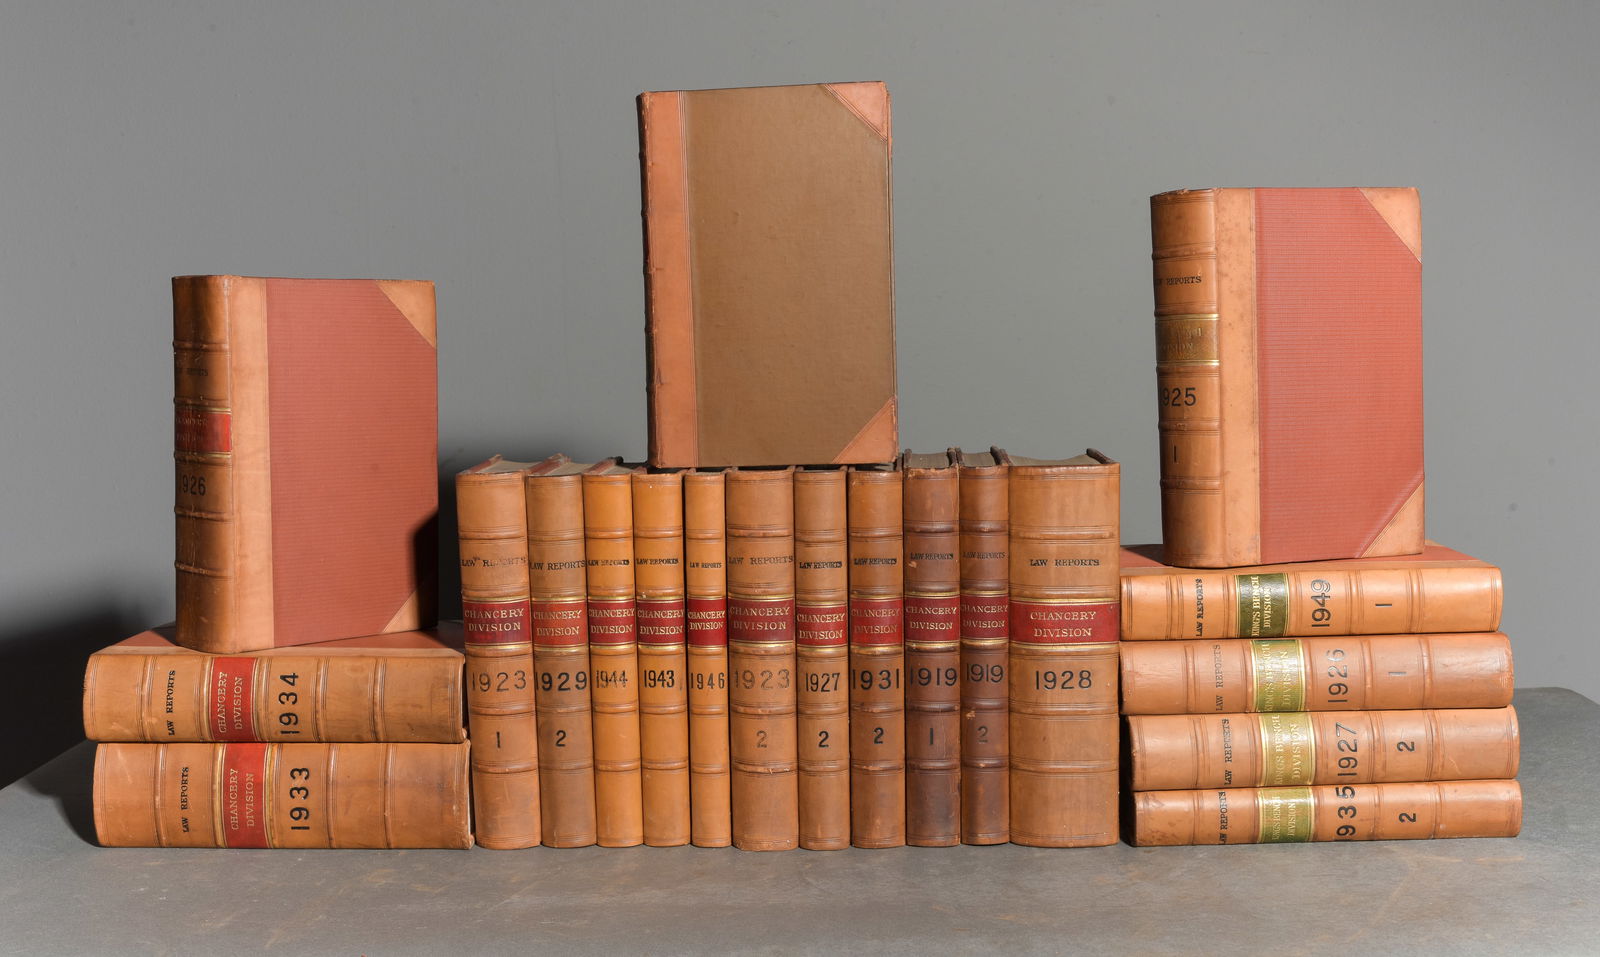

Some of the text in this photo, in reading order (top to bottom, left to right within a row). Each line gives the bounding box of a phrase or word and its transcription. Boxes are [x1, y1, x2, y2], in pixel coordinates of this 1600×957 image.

[1167, 275, 1202, 286] REPORTS
[1160, 387, 1197, 407] 925
[1173, 445, 1178, 463] 1
[750, 555, 794, 565] REPORTS
[910, 552, 954, 560] LAW REPORTS
[977, 552, 1005, 560] REPORTS
[530, 561, 586, 570] LAW REPORTS
[813, 561, 842, 569] REPORTS
[1196, 578, 1204, 619] REPORTS
[1251, 575, 1262, 606] BENCH
[906, 606, 957, 615] CHANCERY
[961, 605, 1008, 613] CHANCERY
[1263, 587, 1273, 628] DIVISION
[1311, 579, 1331, 627] 1949
[464, 608, 525, 619] CHANCERY
[533, 610, 582, 619] CHANCERY
[589, 608, 635, 618] CHANCERY
[637, 609, 684, 619] CHANCERY
[688, 611, 726, 619] CHANCERY
[730, 607, 790, 617] CHANCERY
[797, 613, 845, 623] CHANCERY
[851, 608, 900, 618] CHANCERY
[1030, 611, 1097, 620] CHANCERY
[468, 622, 521, 631] DIVISION
[537, 626, 580, 636] DIVISION
[591, 624, 633, 634] DIVISION
[640, 626, 683, 635] DIVISION
[690, 621, 723, 630] DIVISION
[734, 621, 786, 631] DIVISION
[854, 625, 897, 634] DIVISION
[910, 621, 953, 630] DIVISION
[963, 620, 1004, 629] DIVISION
[1034, 628, 1092, 637] DIVISION
[800, 629, 842, 639] DIVISION
[472, 670, 527, 692] 1923
[535, 671, 587, 691] 1929
[596, 670, 628, 688] 1944
[644, 670, 675, 688] 1943
[690, 672, 724, 690] 1946
[735, 669, 790, 690] 1923
[852, 668, 899, 690] 1931
[910, 667, 957, 686] 1919
[967, 663, 1004, 683] 1919
[1035, 670, 1092, 690] 1928
[1213, 644, 1224, 711] LAW REPORTS
[1326, 649, 1348, 702] 1926
[806, 673, 840, 692] 1927
[166, 670, 176, 713] REPORTS
[219, 671, 228, 733] CHANCERY
[234, 676, 243, 729] DIVISION
[279, 672, 299, 735] 1934
[496, 731, 501, 748] 1
[555, 730, 566, 747] 2
[756, 730, 767, 748] 2
[818, 731, 829, 748] 2
[873, 727, 884, 744] 2
[929, 727, 934, 745] 1
[977, 726, 988, 743] 2
[1271, 715, 1284, 752] BENCH
[1289, 723, 1302, 779] DIVISION
[1336, 722, 1358, 776] 1927
[1397, 741, 1415, 752] 2
[1224, 770, 1233, 785] LAW
[180, 766, 189, 810] REPORTS
[229, 768, 239, 830] CHANCERY
[246, 773, 254, 827] DIVISION
[290, 767, 310, 830] 1933
[1218, 791, 1228, 830] REPORTS
[1287, 802, 1296, 836] DIVISION
[1398, 813, 1416, 823] 2
